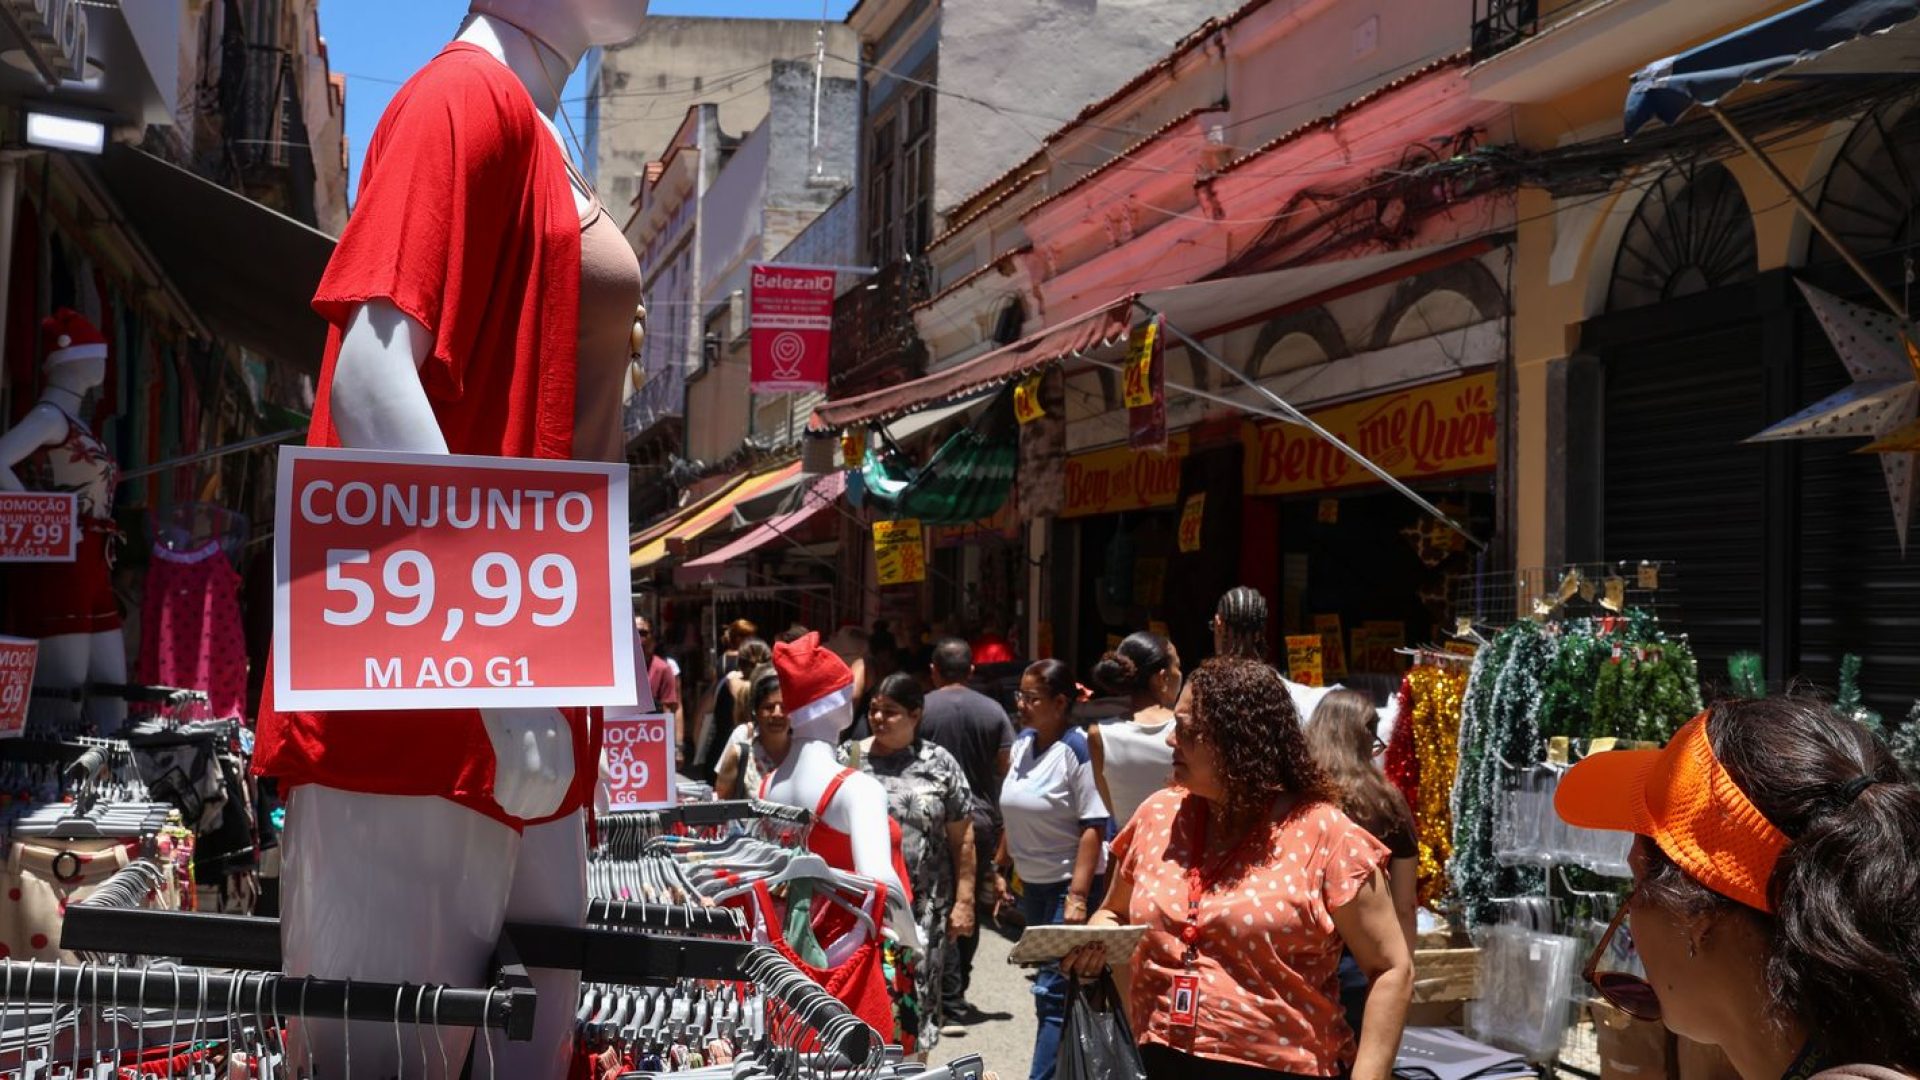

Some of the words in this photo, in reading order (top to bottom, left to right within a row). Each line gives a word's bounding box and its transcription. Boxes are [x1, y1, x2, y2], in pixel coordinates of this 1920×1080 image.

[1257, 426, 1350, 487] Bem
[1358, 402, 1410, 457] me
[300, 479, 594, 533] CONJUNTO
[323, 548, 579, 642] 59,99
[364, 657, 403, 688] M
[415, 656, 474, 688] AO
[485, 656, 535, 688] G1
[603, 723, 665, 748] OÇÃO
[615, 790, 638, 803] GG
